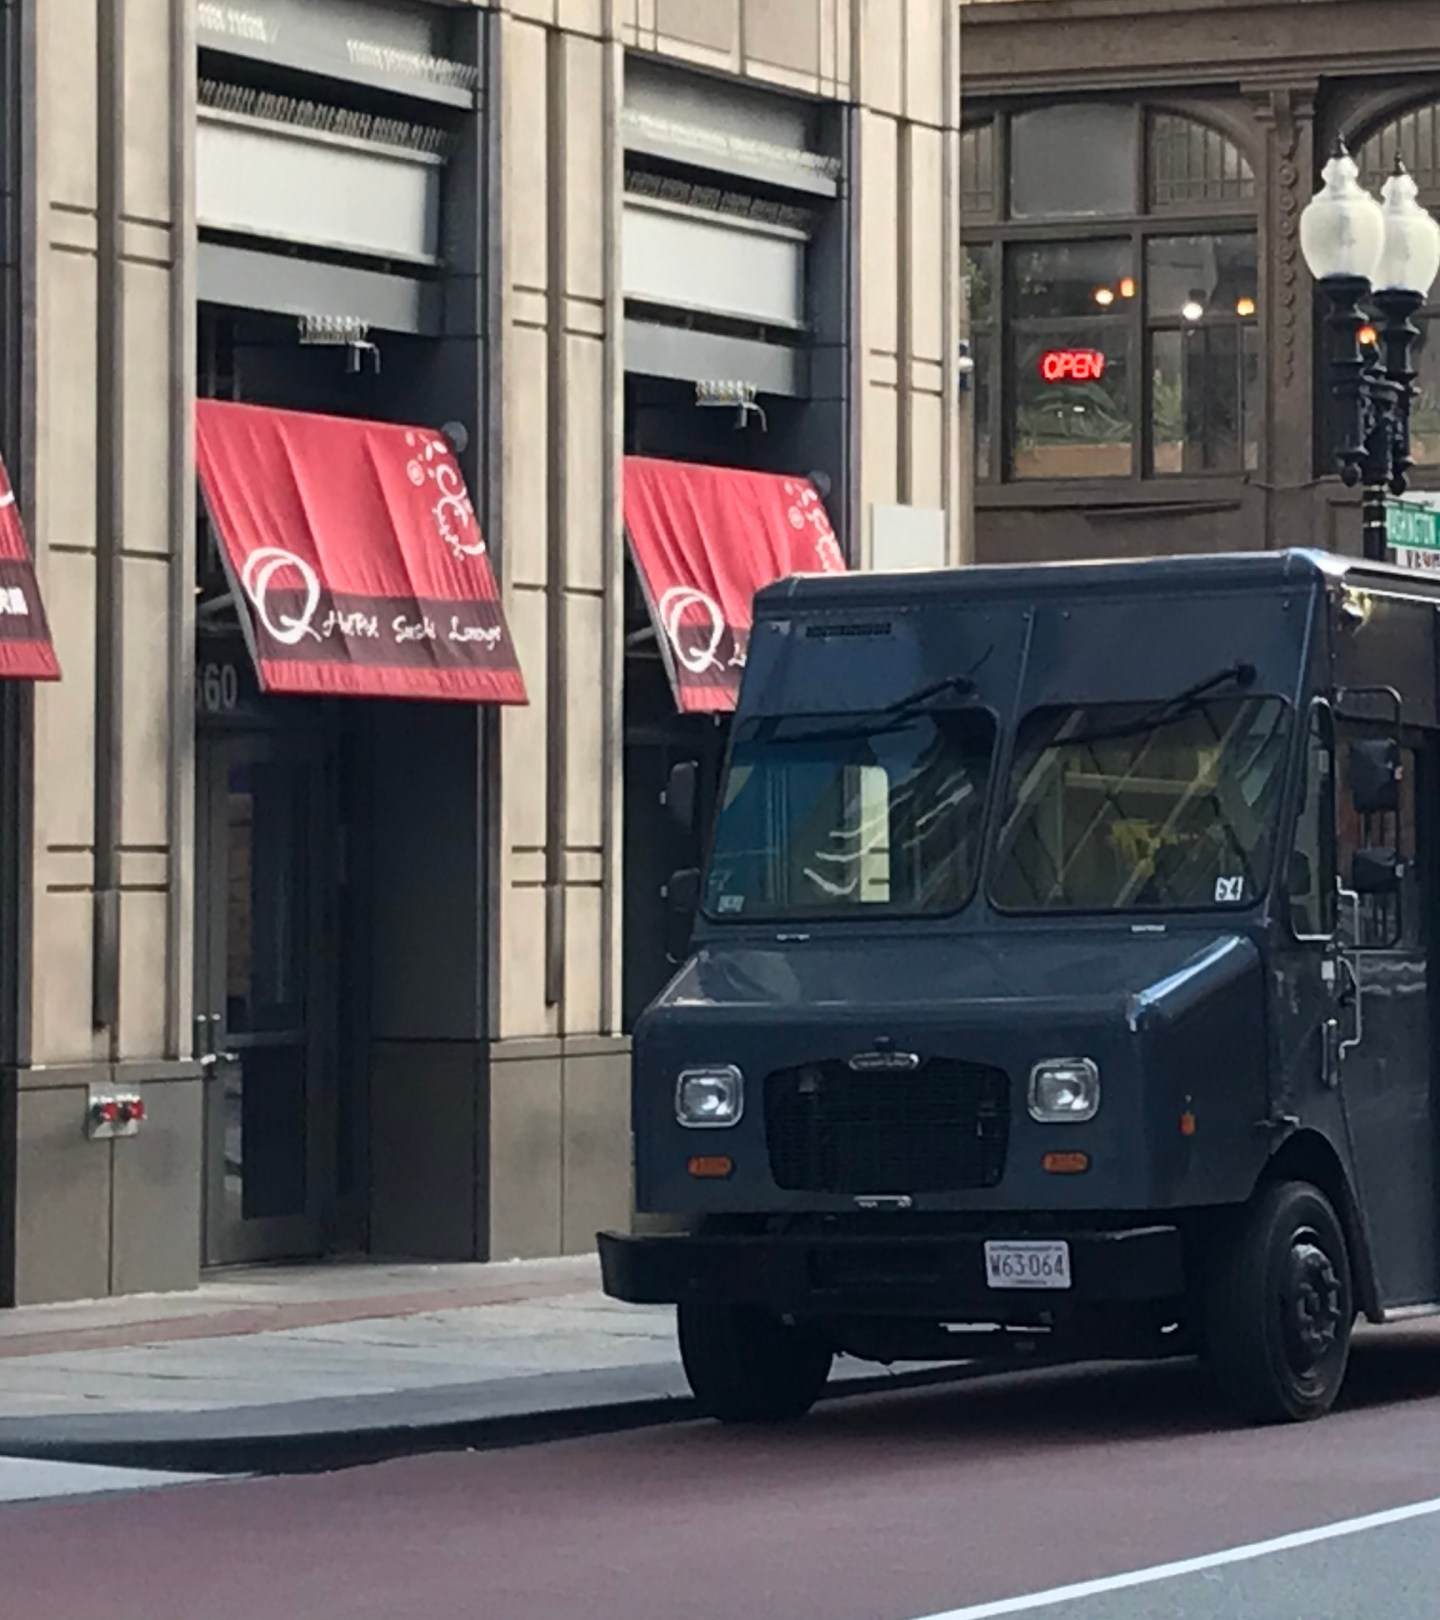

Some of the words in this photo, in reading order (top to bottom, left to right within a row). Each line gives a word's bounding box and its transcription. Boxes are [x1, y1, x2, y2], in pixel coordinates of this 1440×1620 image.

[1043, 351, 1105, 380] OPEN
[241, 546, 322, 645] Q
[659, 586, 725, 673] Q
